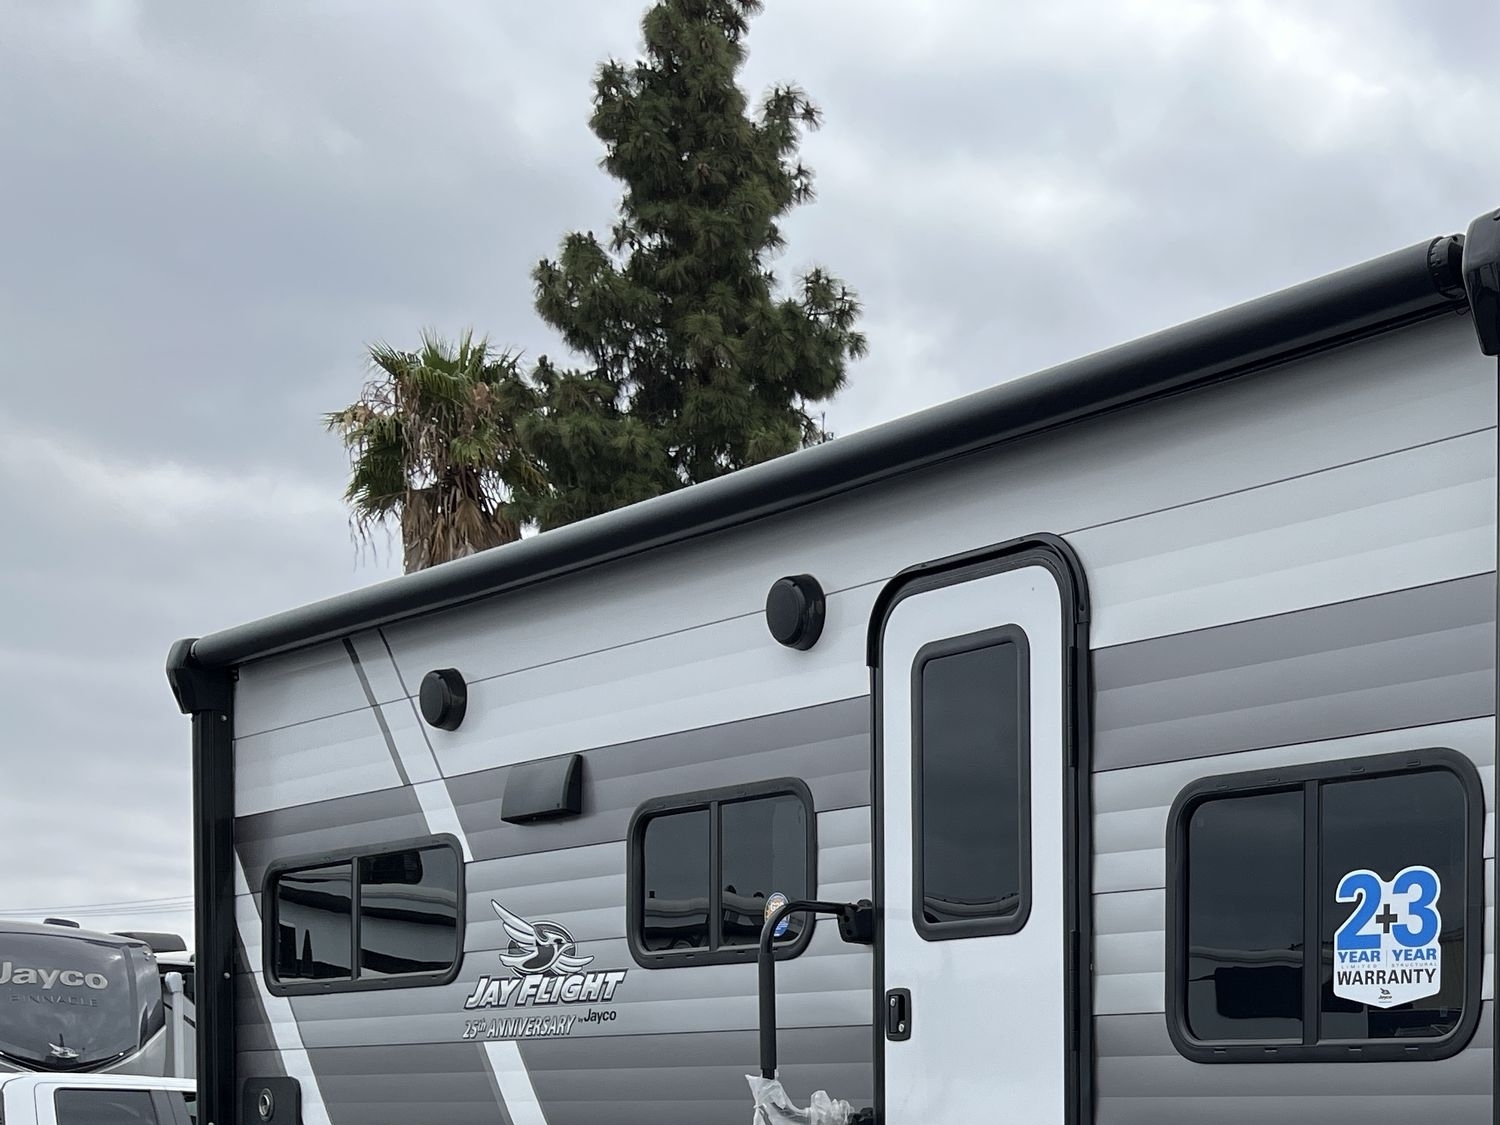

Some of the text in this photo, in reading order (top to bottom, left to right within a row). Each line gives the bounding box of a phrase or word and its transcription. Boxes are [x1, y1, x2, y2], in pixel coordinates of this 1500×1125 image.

[1338, 948, 1437, 963] YEAR YEAR
[0, 962, 108, 989] Jayco
[1337, 968, 1436, 985] WARRANTY
[10, 994, 98, 1007] PINNACLE
[584, 1009, 617, 1024] Jayco
[463, 1014, 576, 1039] 25th ANNIVERSARY
